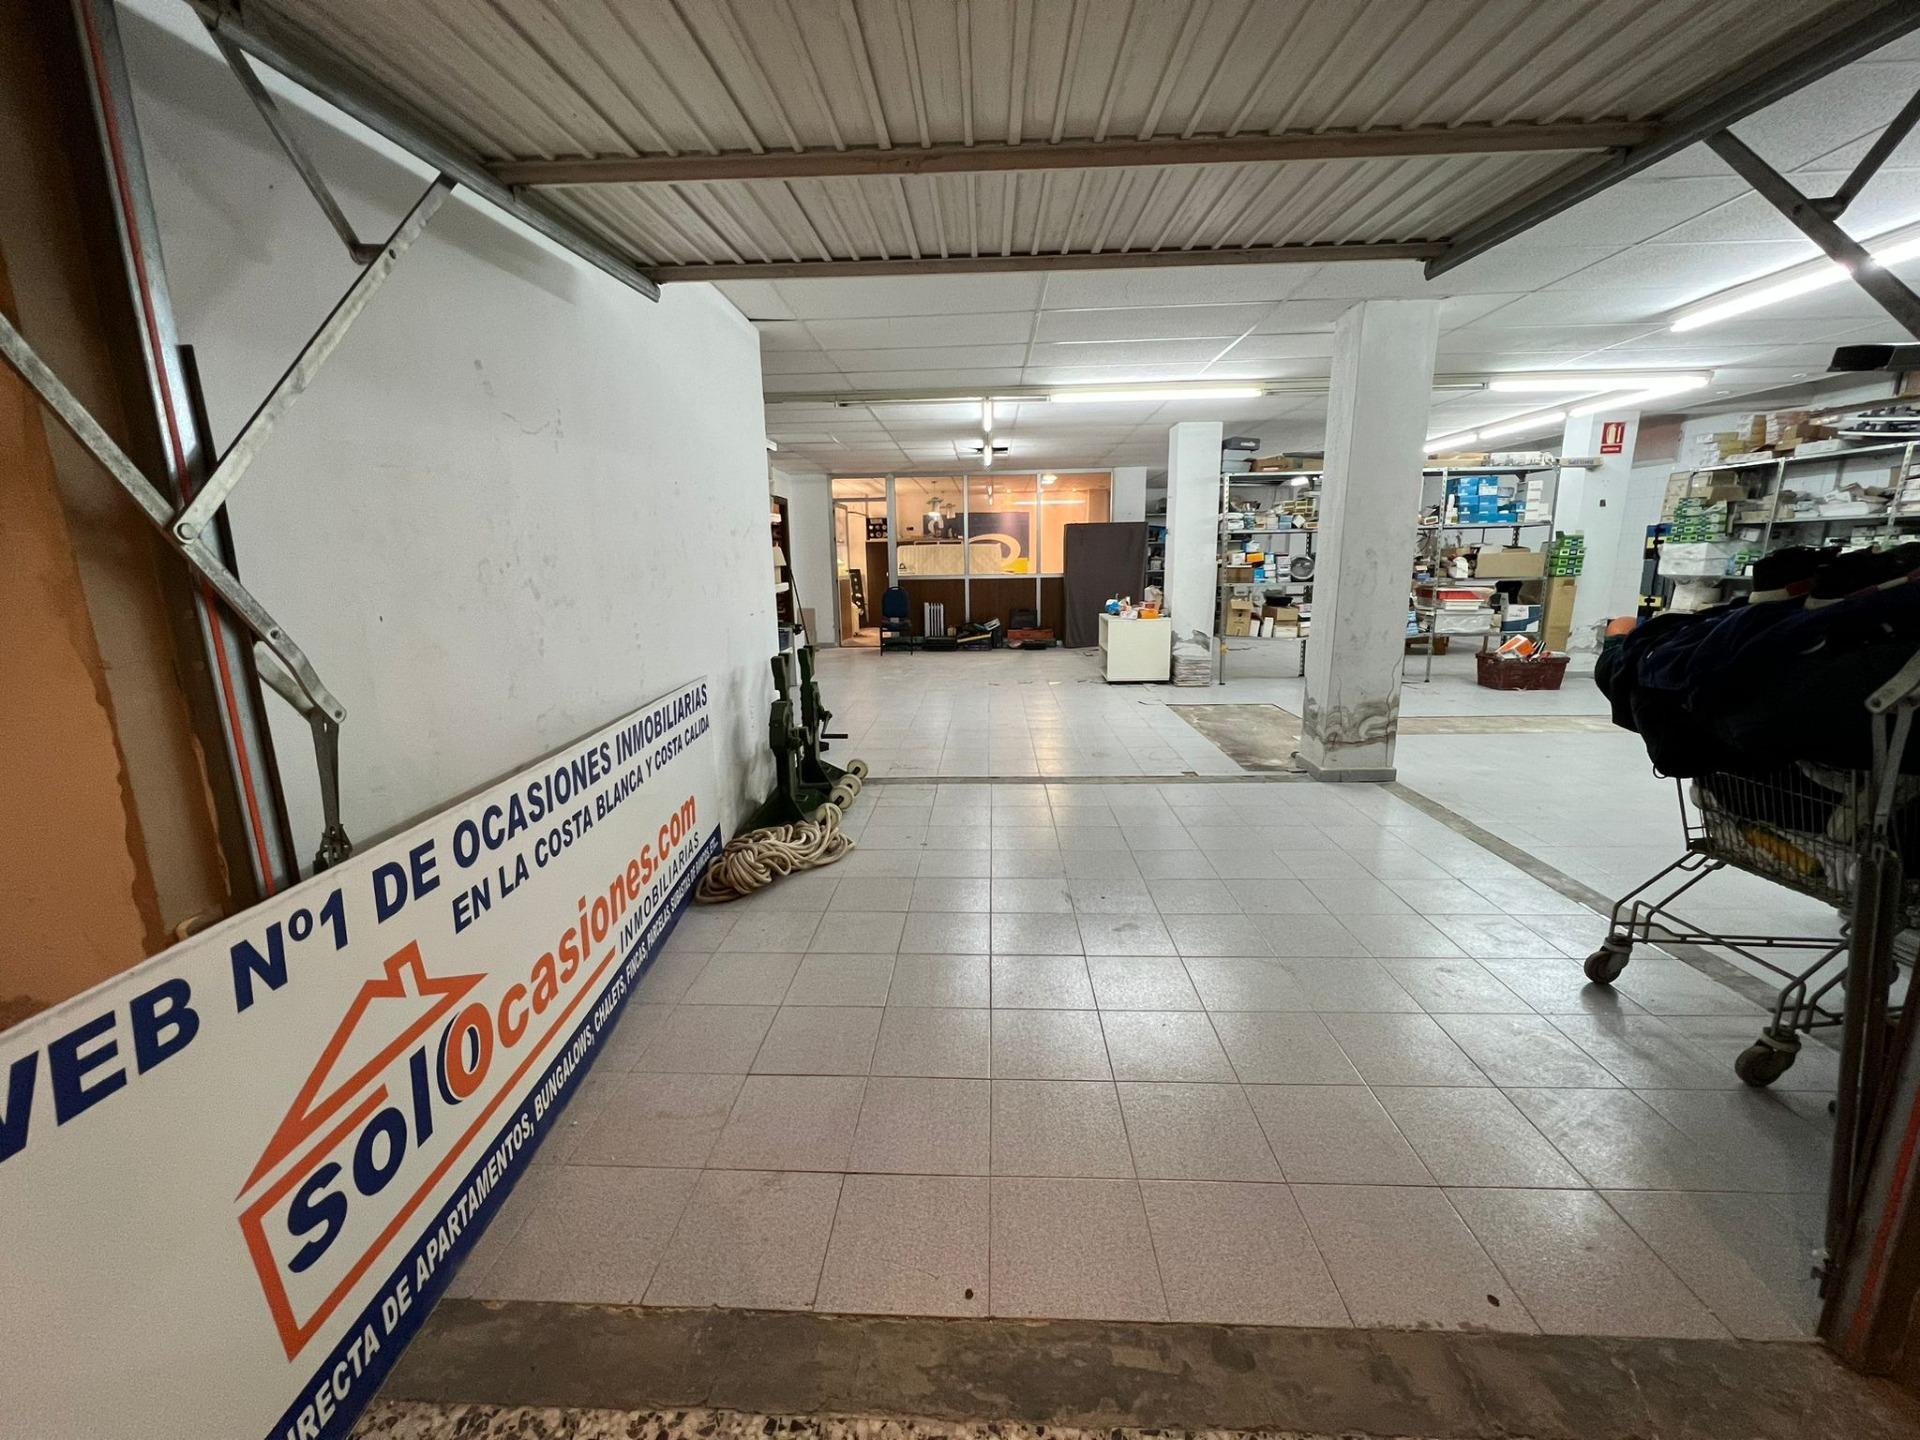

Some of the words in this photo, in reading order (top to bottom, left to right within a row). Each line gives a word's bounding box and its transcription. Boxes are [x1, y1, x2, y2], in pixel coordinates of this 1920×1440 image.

[371, 838, 441, 925] DE
[452, 741, 612, 869] OCASIONES
[616, 682, 708, 766] INMOBILIARIAS
[452, 877, 492, 935] EN
[498, 853, 531, 899] LA
[534, 804, 594, 868] COSTA
[597, 773, 644, 821] BLANCA
[645, 755, 655, 778] Y
[655, 734, 683, 771] COSTA
[620, 831, 700, 954] INMOBILIARIAS
[382, 1274, 413, 1336] DE
[415, 1112, 535, 1293] APARTAMENTOS,
[534, 1024, 595, 1122] BUNGALOWS,
[593, 975, 627, 1033] CHALETS,
